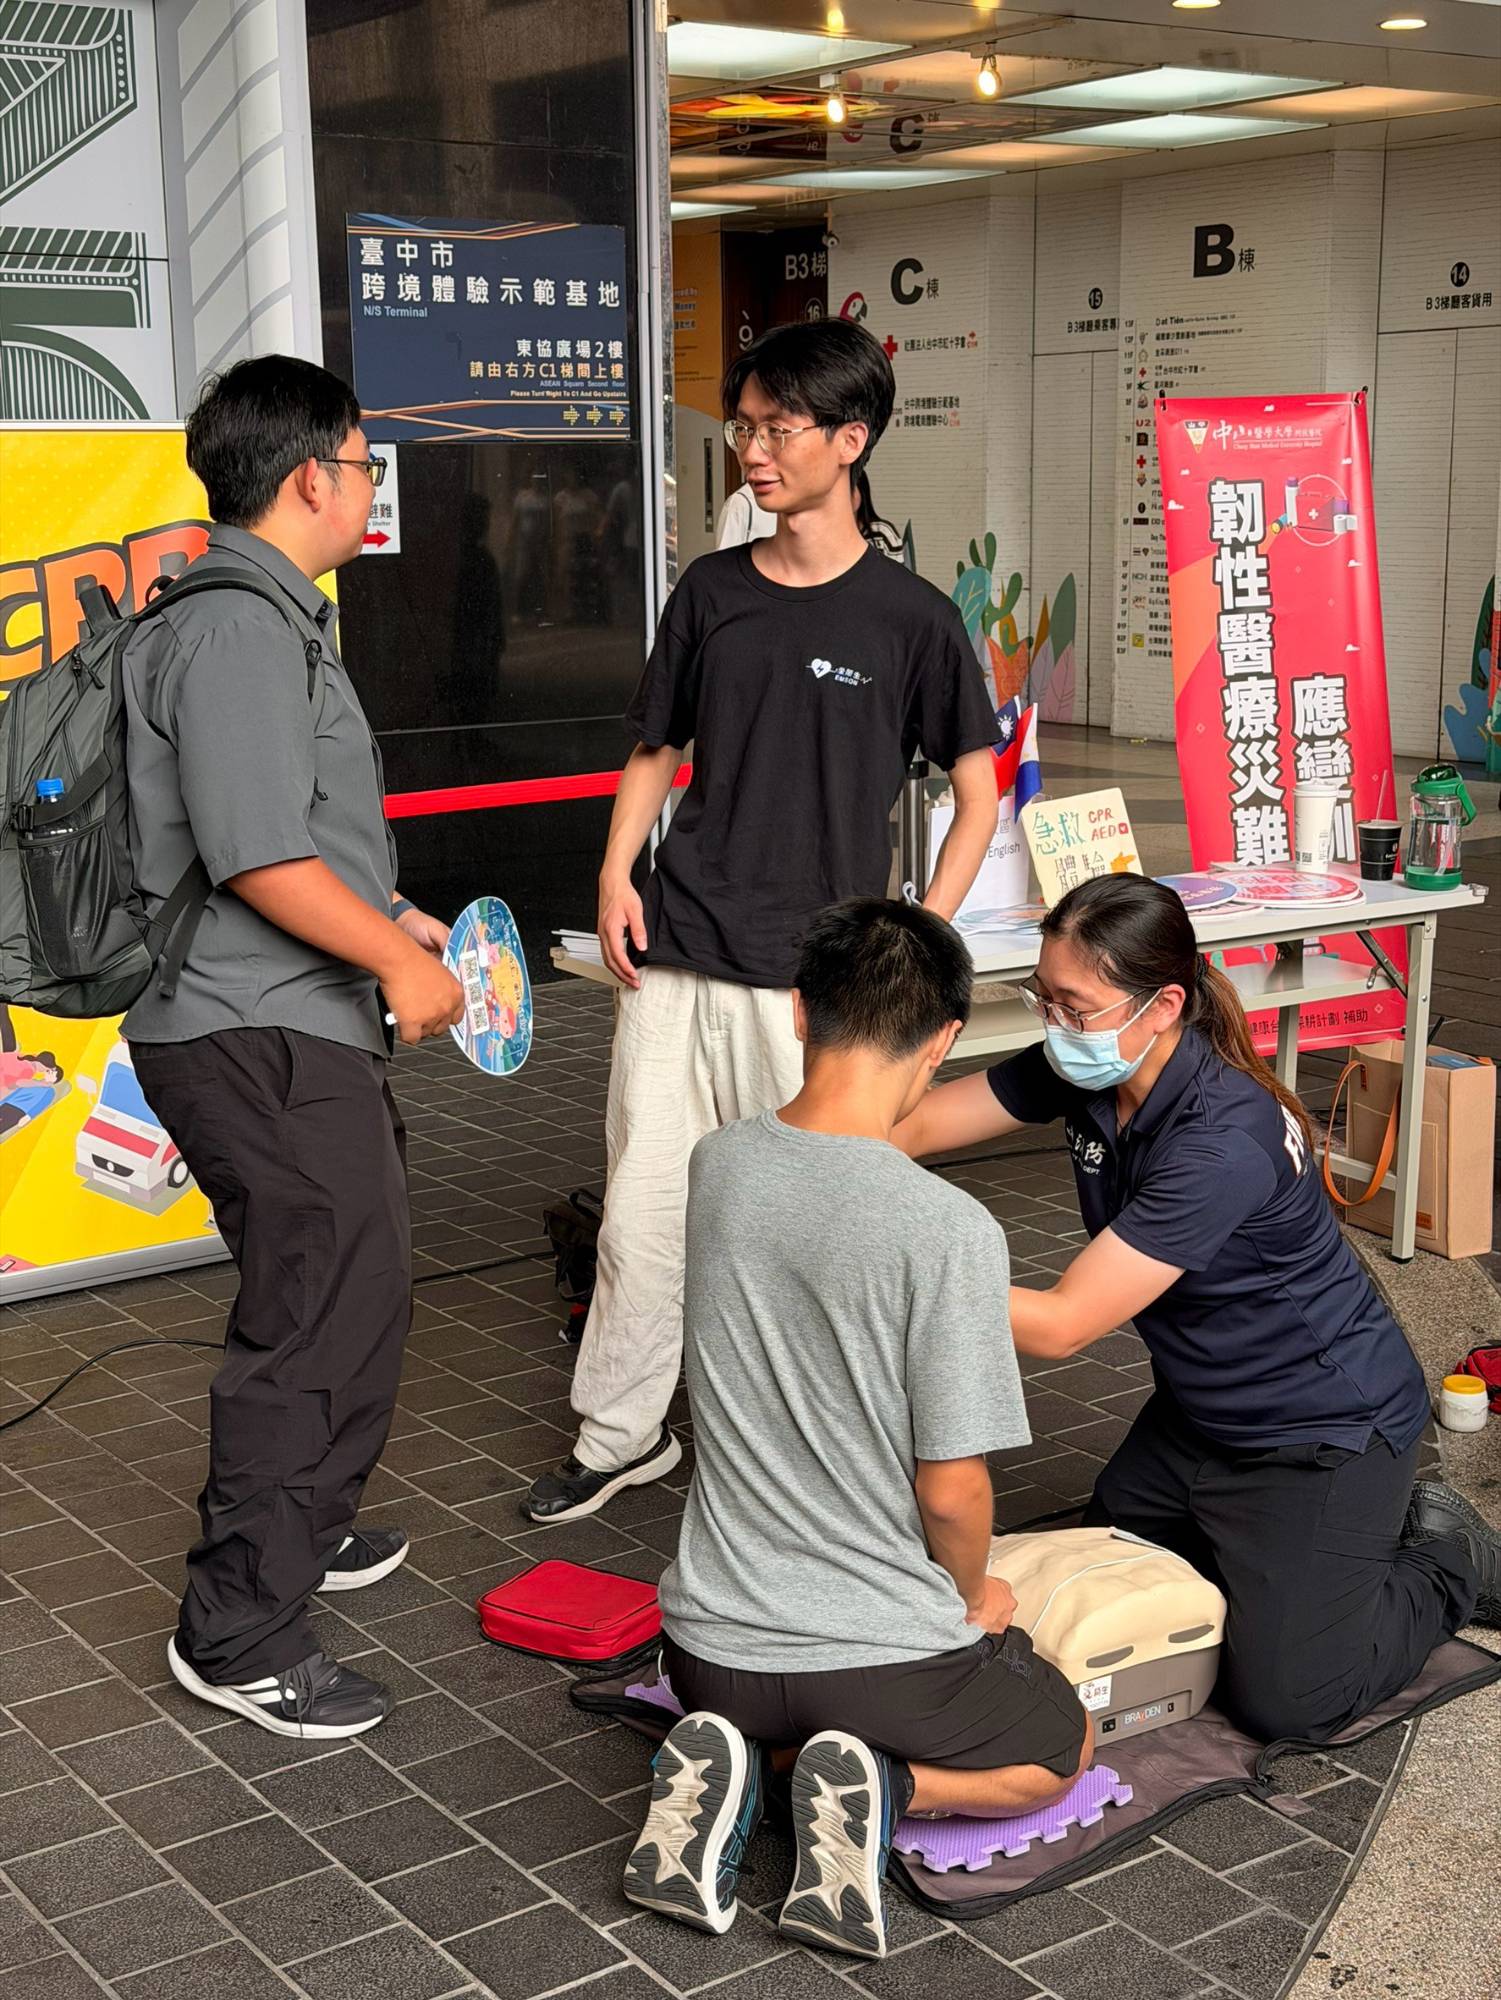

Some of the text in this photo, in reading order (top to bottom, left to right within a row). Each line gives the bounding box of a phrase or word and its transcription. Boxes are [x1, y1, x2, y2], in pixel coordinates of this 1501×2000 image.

[360, 237, 454, 269] 臺中市
[785, 251, 827, 280] B3梯
[362, 272, 621, 308] 跨境體驗示範基地
[363, 305, 428, 318] N/S Terminal
[516, 339, 623, 359] 東協廣場2樓
[469, 361, 624, 379] 請由右方C1梯間上樓
[540, 380, 561, 388] ASEAN
[587, 380, 609, 388] Second
[1136, 419, 1151, 427] U2
[1210, 480, 1290, 865] 韌性醫療災難
[1032, 807, 1113, 855] 急救 CPR
[1091, 826, 1117, 842] AED
[987, 841, 1021, 859] English
[1343, 1009, 1369, 1025] 補助
[1082, 1165, 1101, 1176] DEPT
[1124, 1704, 1161, 1725] BRAYDEN
